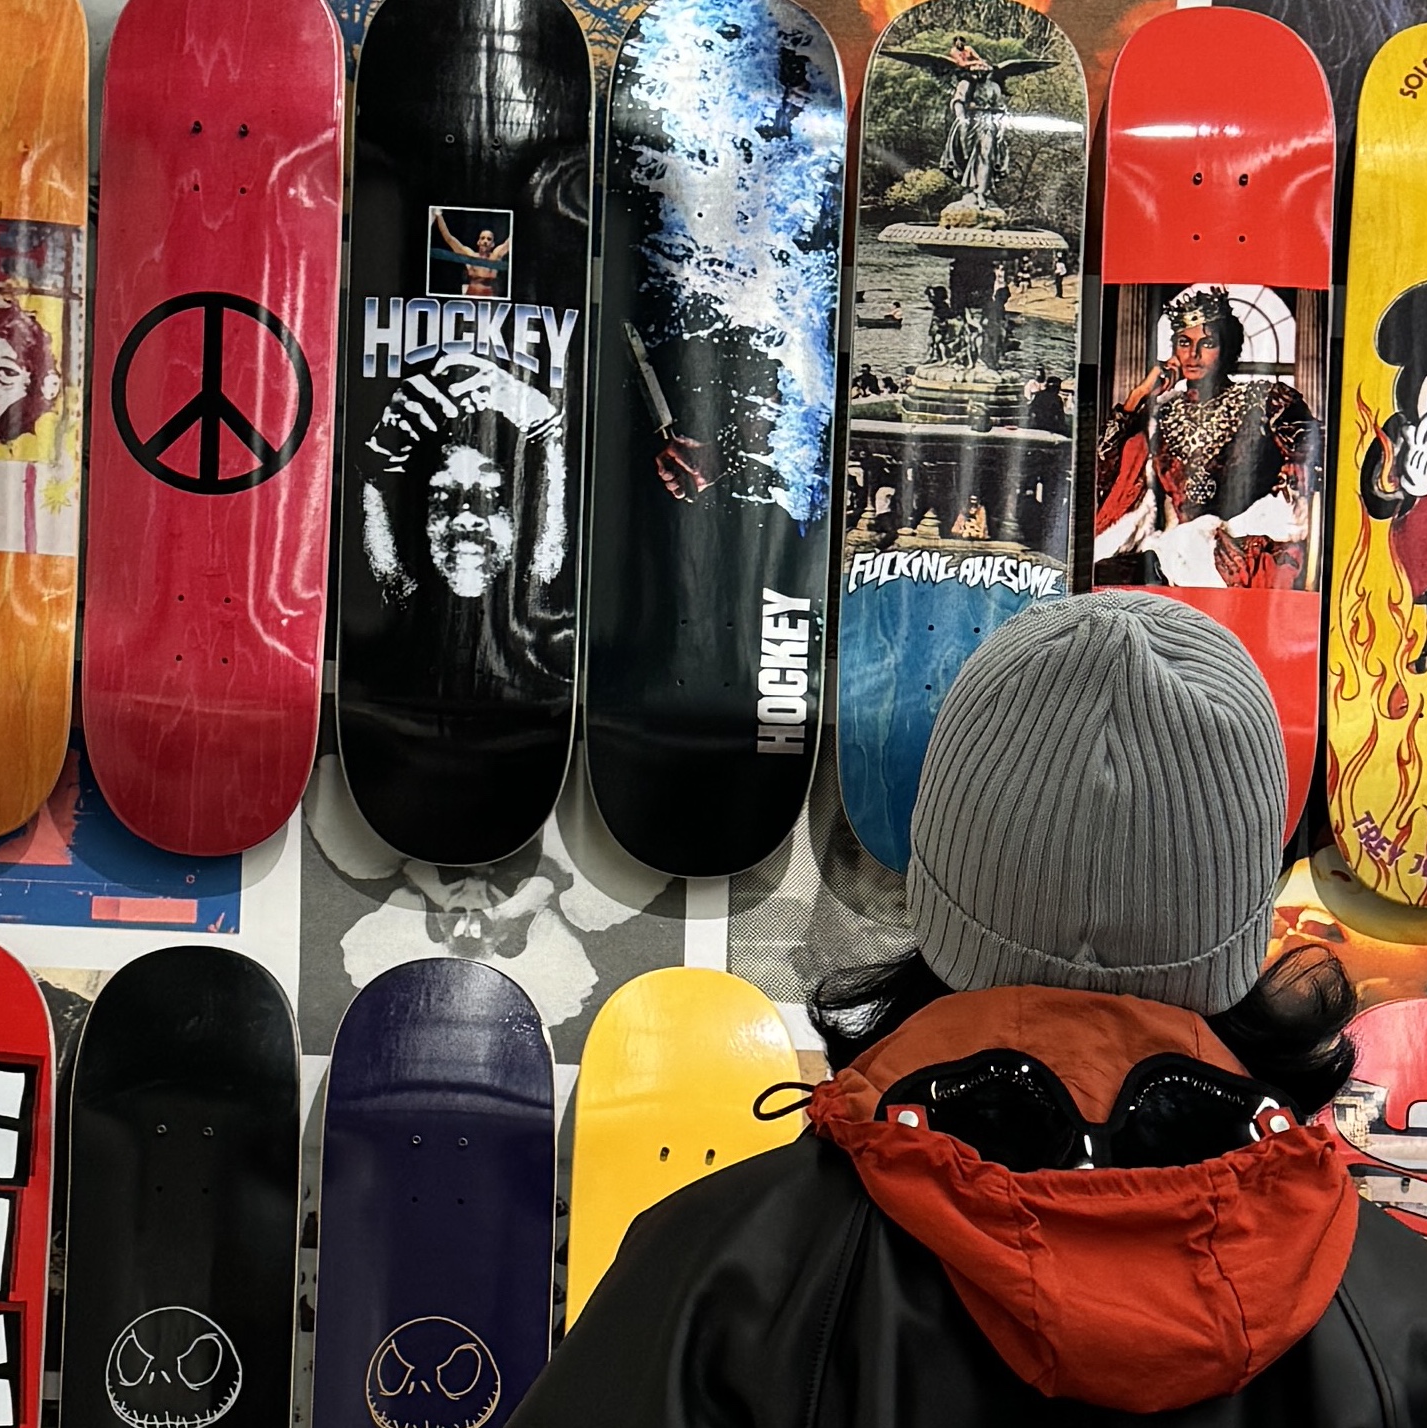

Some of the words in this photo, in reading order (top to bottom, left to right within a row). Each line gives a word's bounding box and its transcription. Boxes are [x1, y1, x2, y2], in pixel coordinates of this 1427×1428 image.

[363, 297, 579, 388] HOCKEY
[848, 550, 958, 593] FUCKING
[958, 556, 1063, 598] AWESOME
[757, 587, 810, 753] HOCKEY
[1353, 810, 1406, 866] TREY
